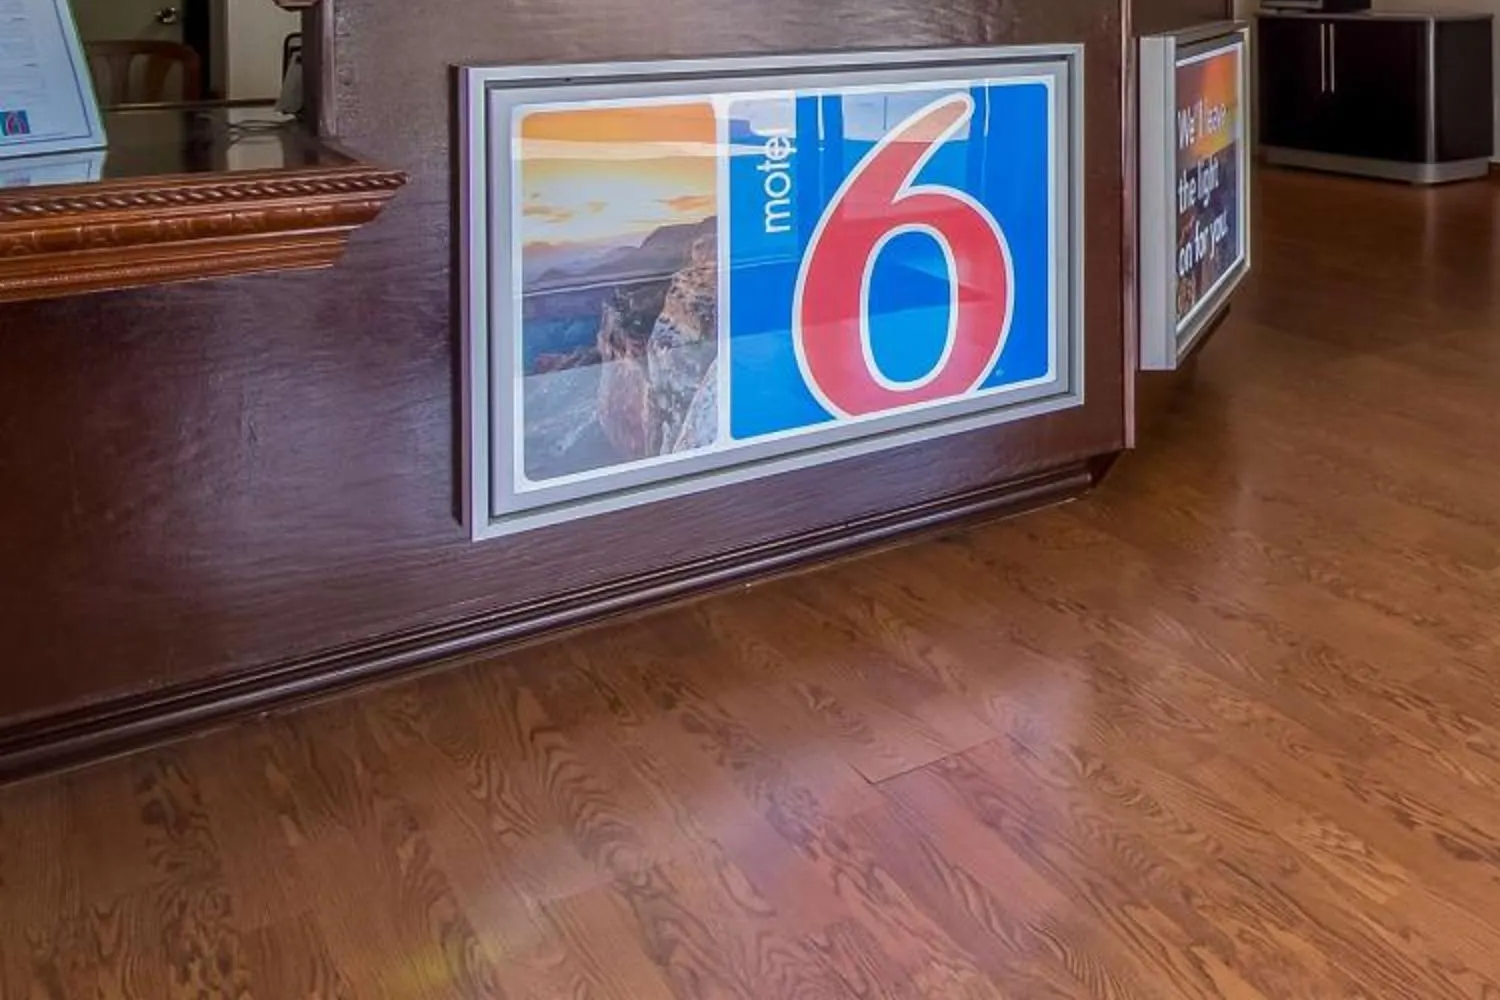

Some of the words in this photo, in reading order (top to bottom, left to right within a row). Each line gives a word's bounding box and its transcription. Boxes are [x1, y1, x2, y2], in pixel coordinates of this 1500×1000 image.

[1178, 168, 1196, 215] the
[1197, 154, 1219, 208] light
[792, 91, 1015, 420] 6
[1178, 241, 1193, 277] on
[1194, 219, 1209, 263] for
